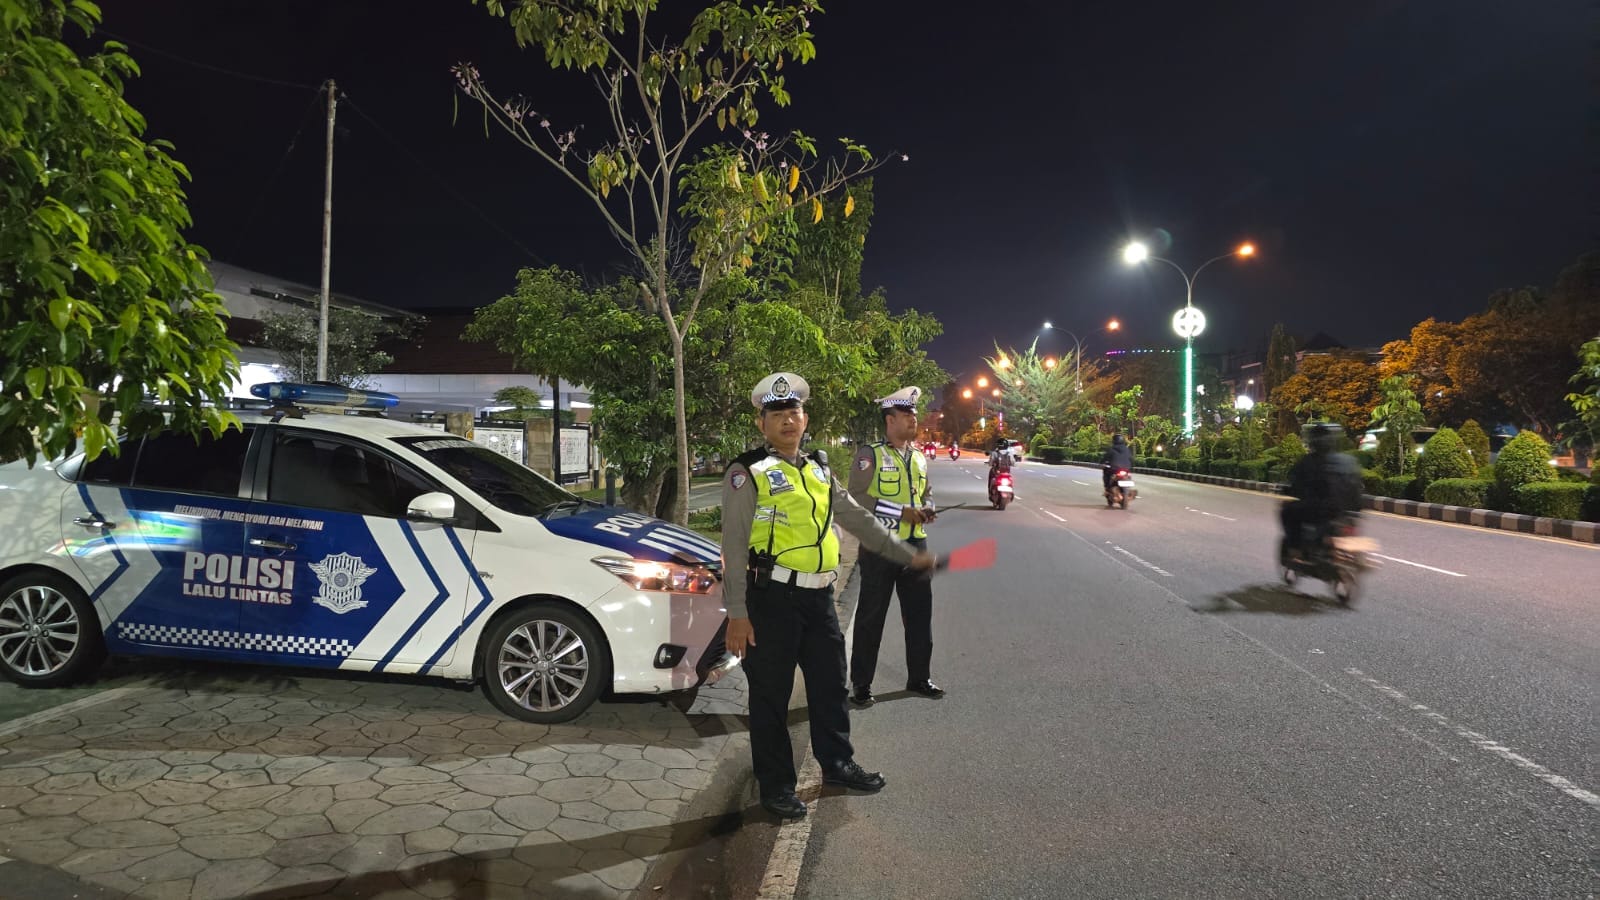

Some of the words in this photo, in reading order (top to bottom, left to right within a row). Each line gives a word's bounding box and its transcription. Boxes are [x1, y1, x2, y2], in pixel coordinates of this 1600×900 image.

[183, 551, 295, 590] POLISI
[183, 582, 226, 598] LALU
[229, 587, 292, 605] LINTAS
